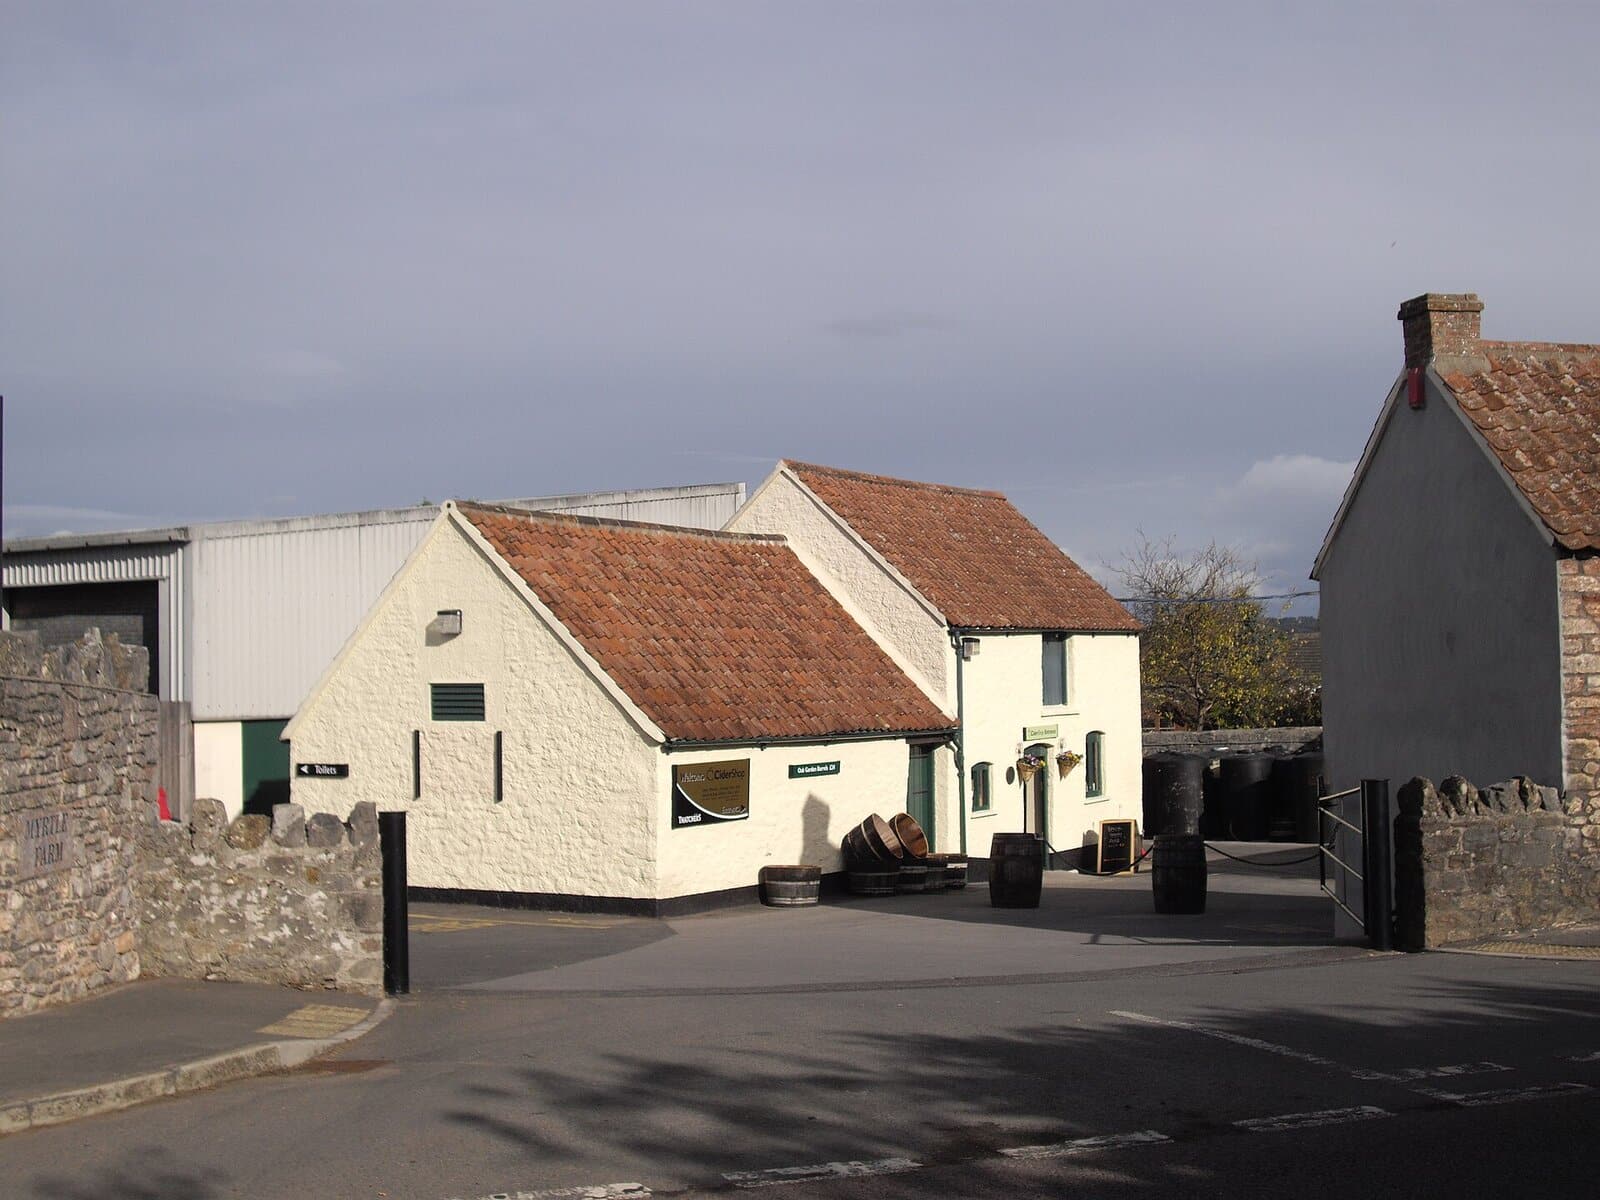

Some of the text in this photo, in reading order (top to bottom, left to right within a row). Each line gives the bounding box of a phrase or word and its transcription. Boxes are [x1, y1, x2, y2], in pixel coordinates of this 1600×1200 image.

[315, 764, 337, 774] Toilets
[26, 812, 69, 839] MYRTLE
[35, 841, 63, 867] FARM
